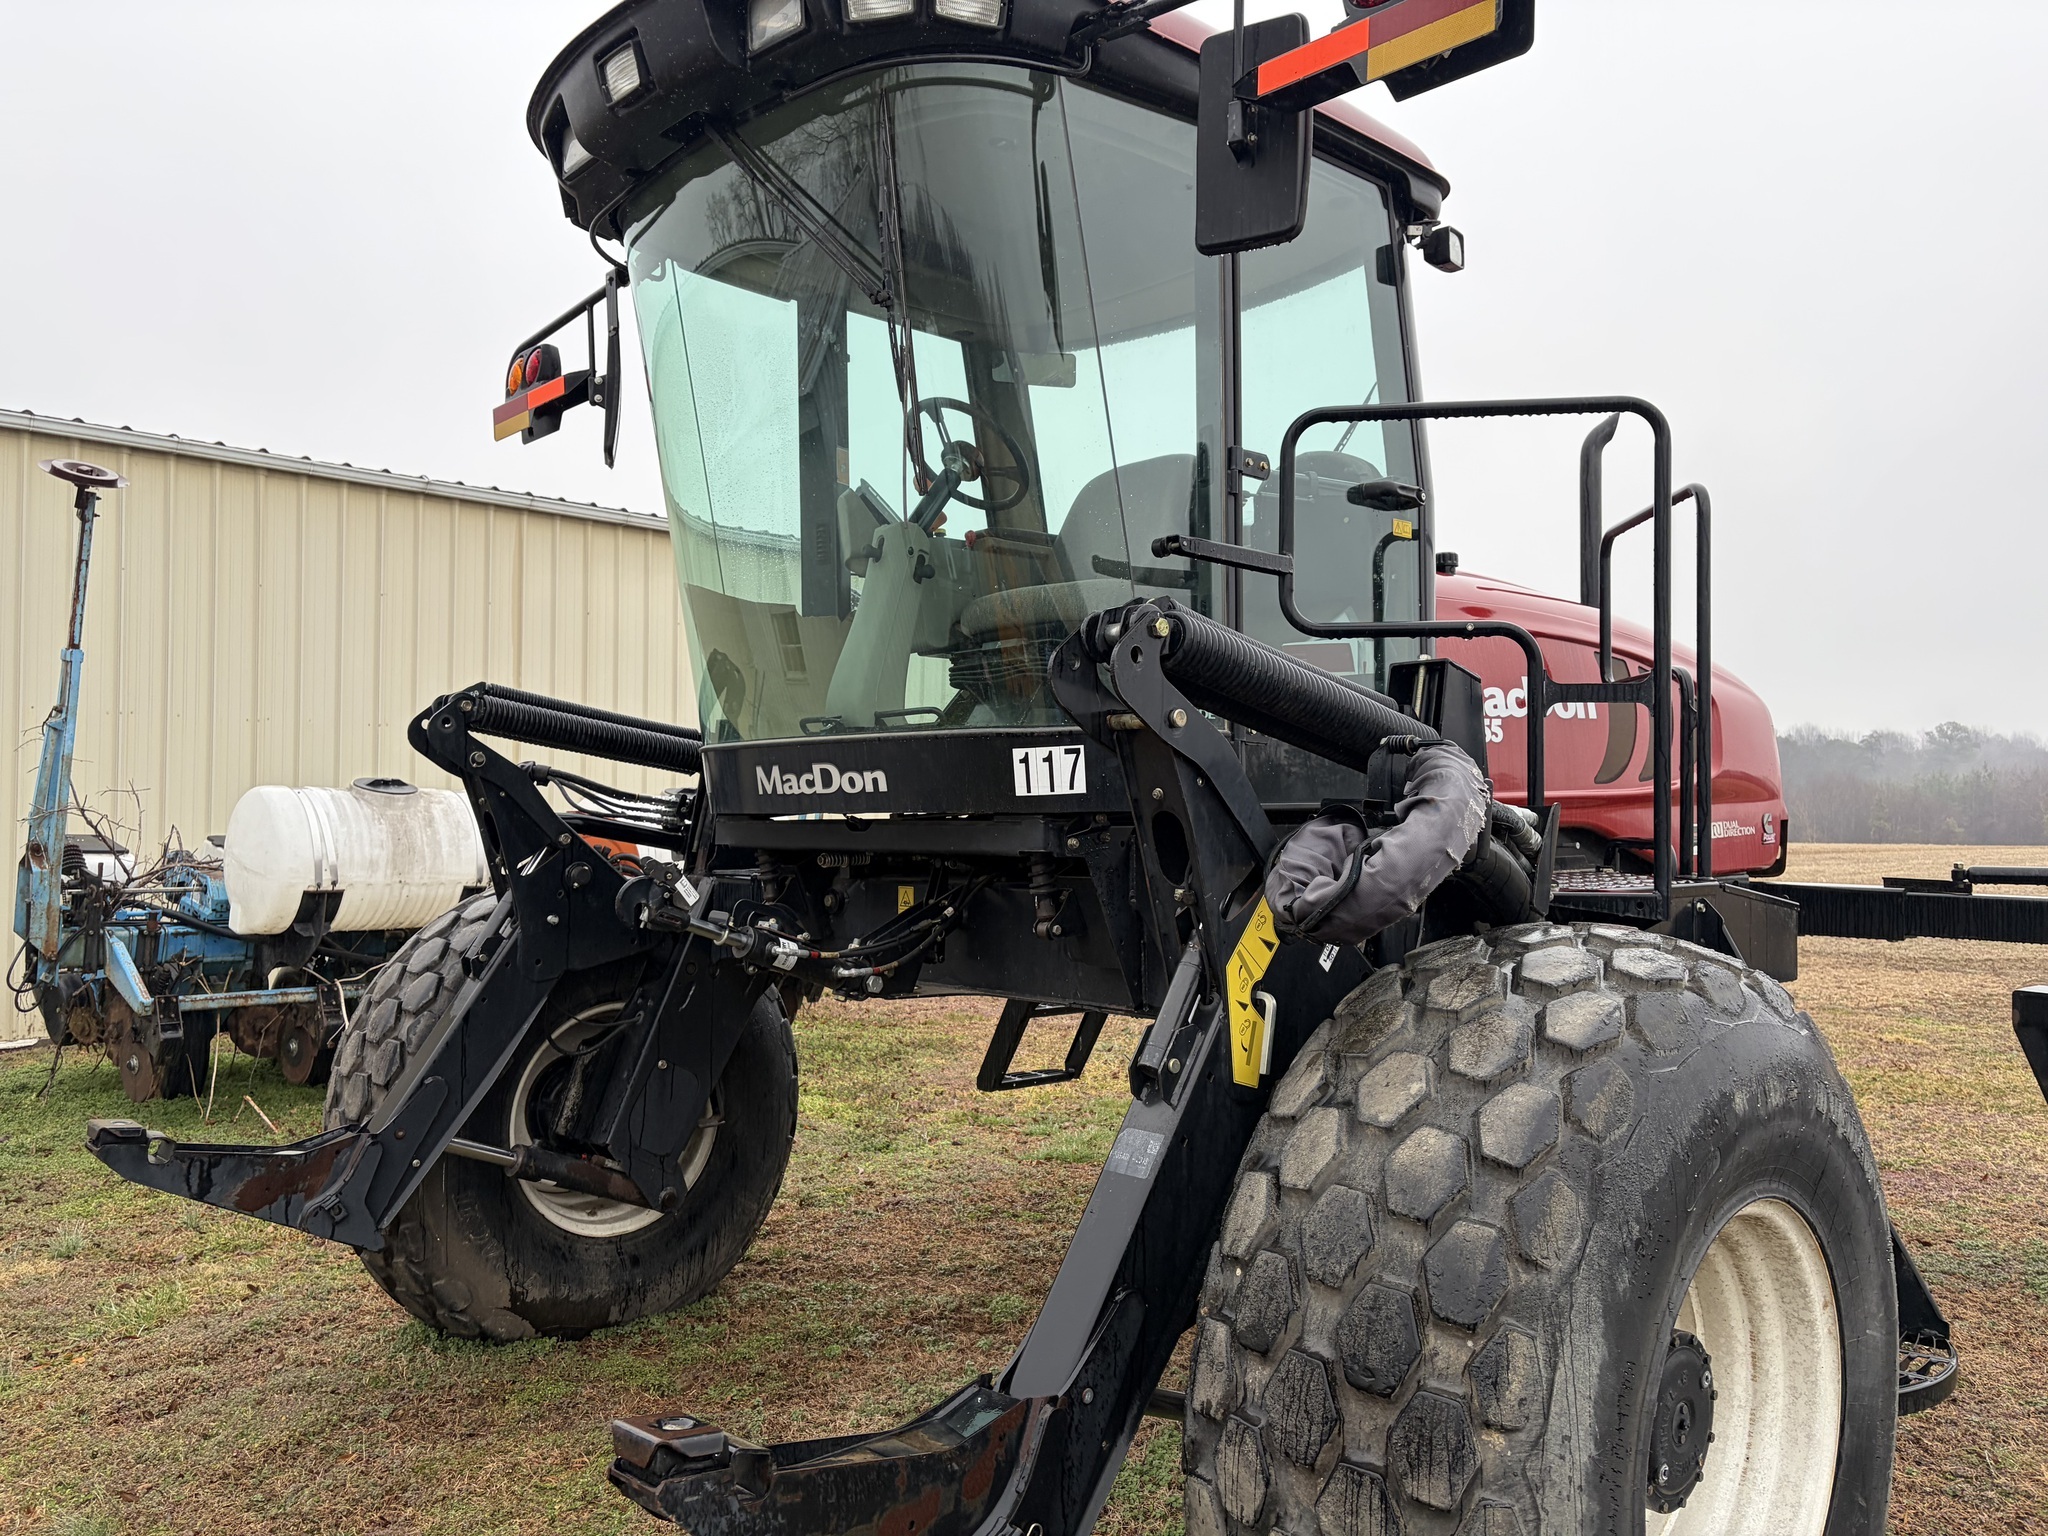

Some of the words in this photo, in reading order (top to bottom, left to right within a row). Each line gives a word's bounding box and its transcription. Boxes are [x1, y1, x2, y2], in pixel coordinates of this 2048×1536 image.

[755, 762, 888, 795] MacDon
[1018, 747, 1082, 794] 117
[1723, 820, 1740, 829] DUAL
[1723, 826, 1756, 838] DIRECTION
